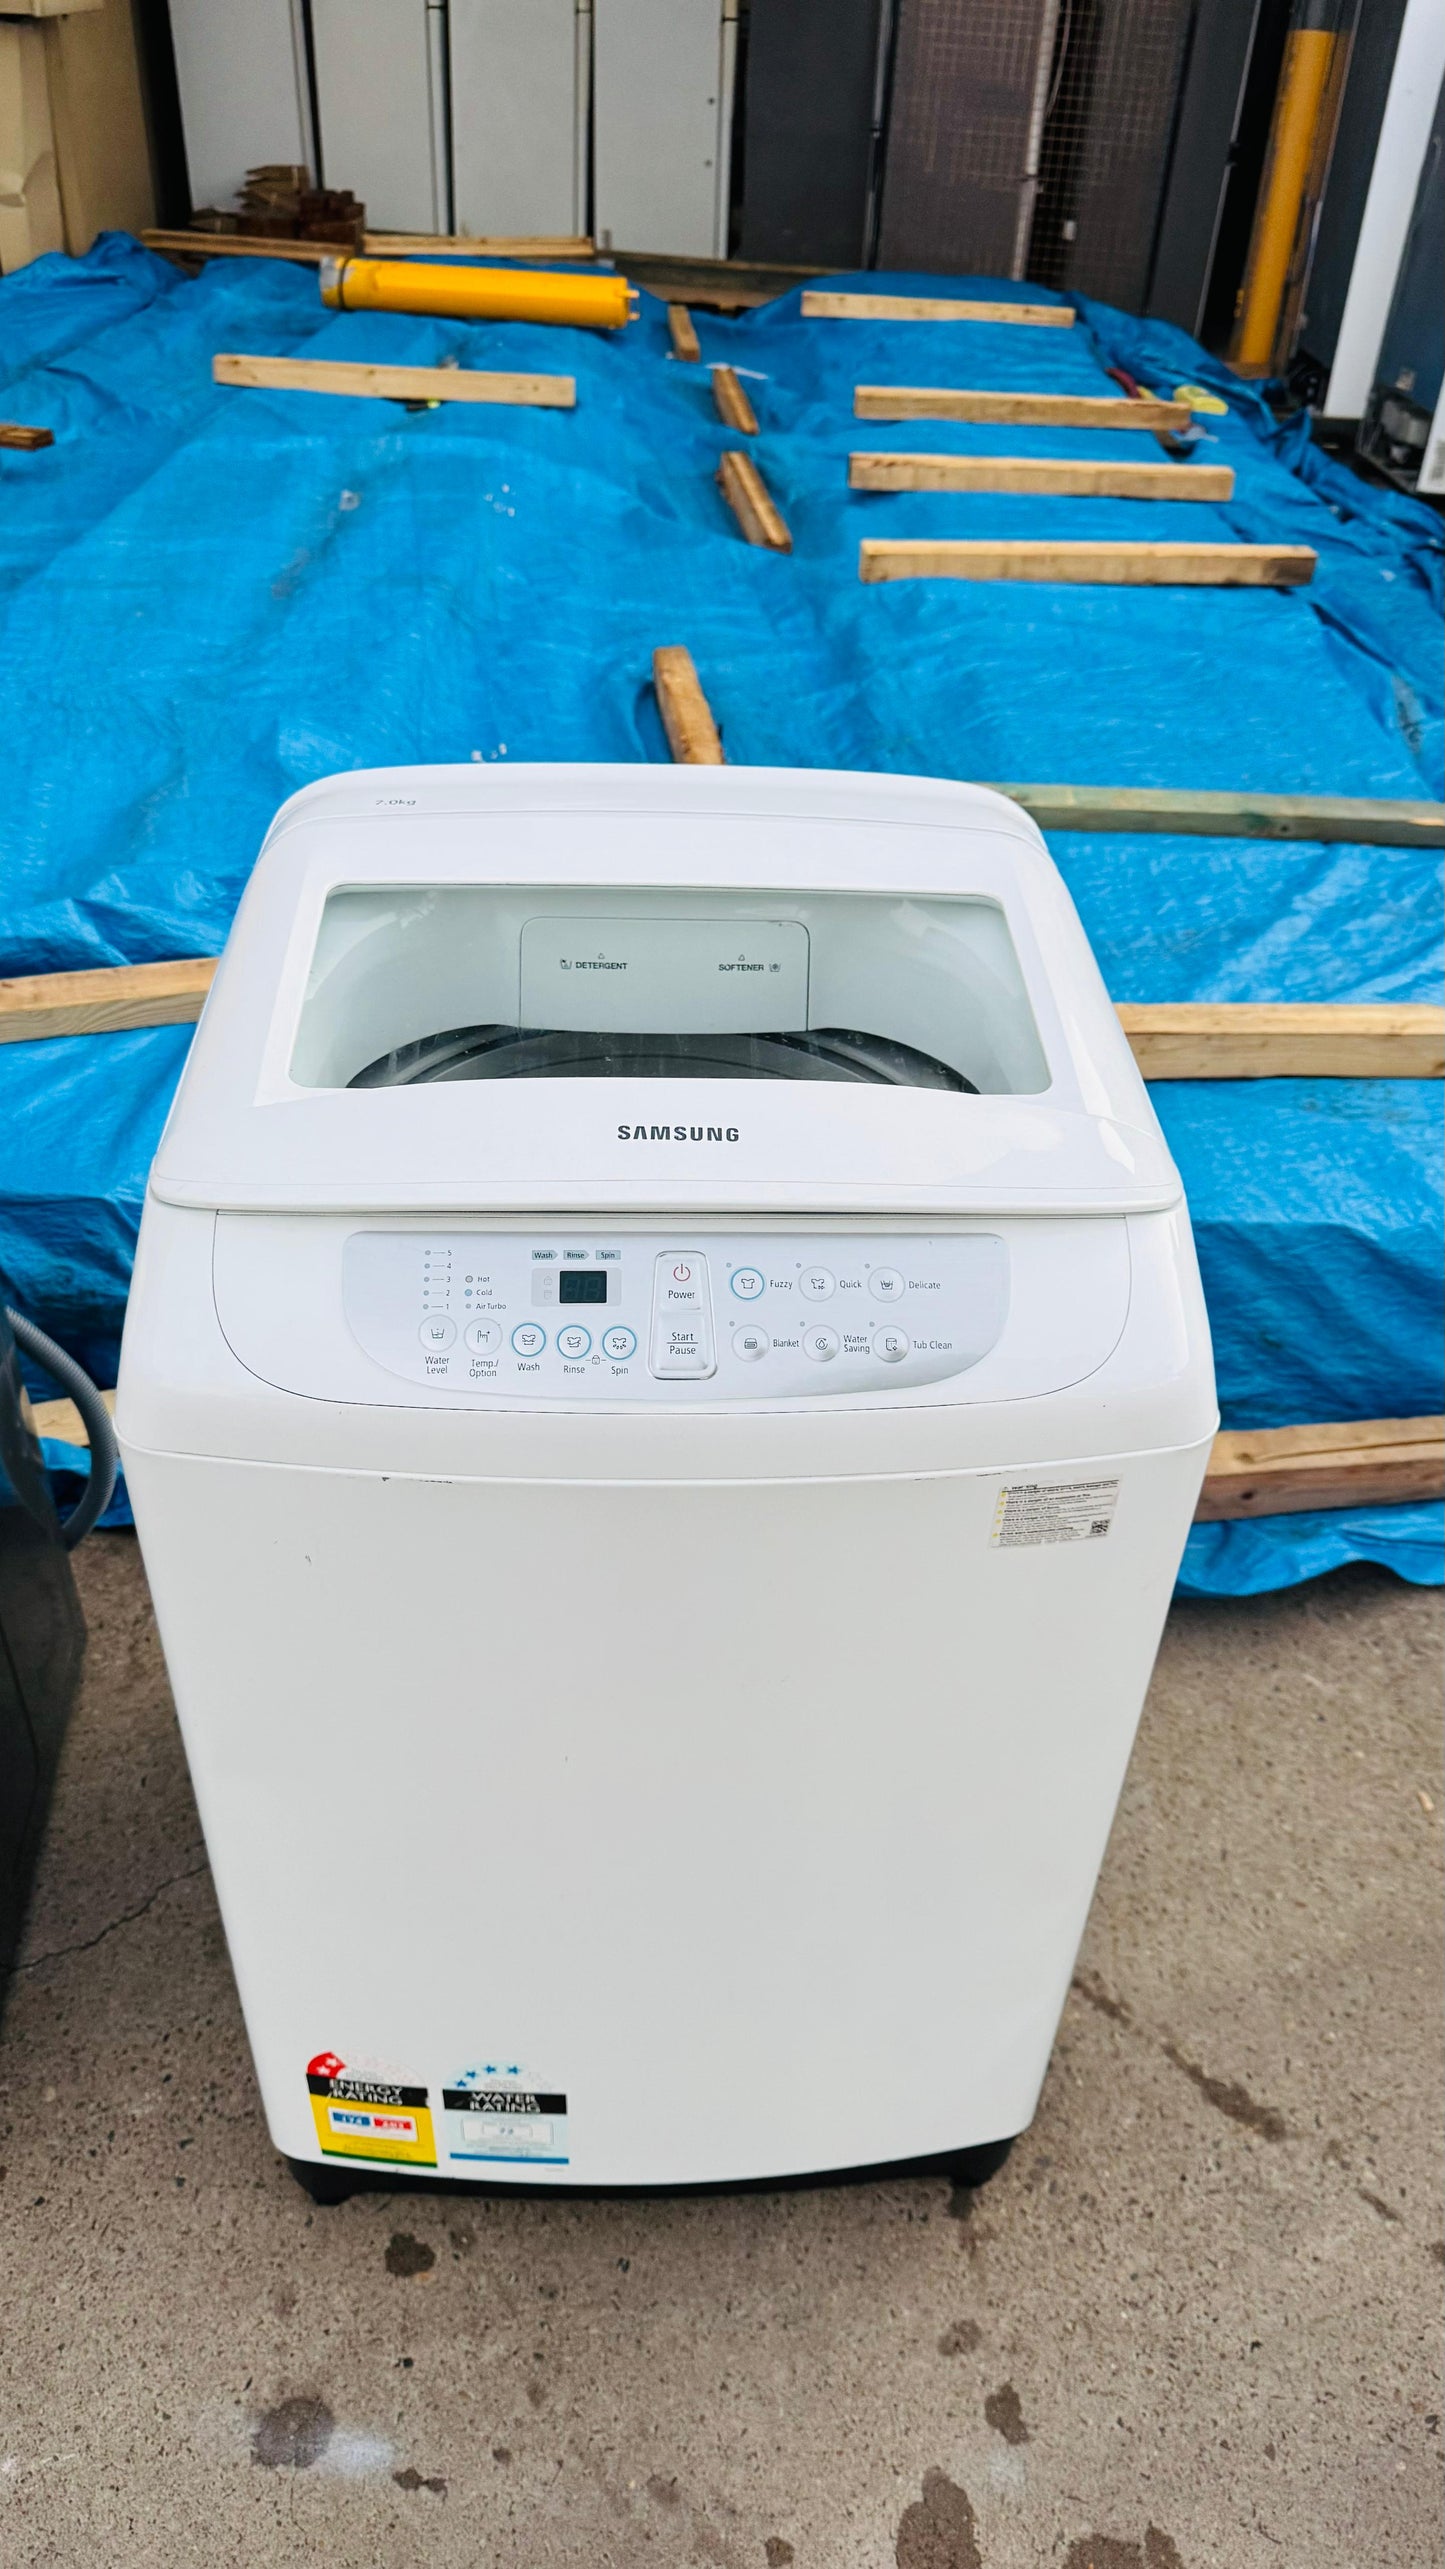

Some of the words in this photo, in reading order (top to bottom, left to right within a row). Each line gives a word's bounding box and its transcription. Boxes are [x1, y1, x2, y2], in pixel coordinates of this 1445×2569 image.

[575, 961, 628, 970] DETERGENT
[718, 963, 765, 972] SOFTENER
[617, 1125, 740, 1142] SAMSUNG
[600, 1252, 616, 1260] Spin
[769, 1280, 793, 1290] Fuzzy
[839, 1280, 863, 1289] Quick
[908, 1281, 941, 1290] Delicate
[668, 1290, 695, 1299] Power
[671, 1332, 694, 1342] Start
[843, 1335, 868, 1343] Water
[773, 1339, 800, 1348] Blanket
[913, 1341, 928, 1349] Tub
[929, 1341, 953, 1350] Clean
[669, 1345, 696, 1355] Pause
[843, 1344, 871, 1354] Saving
[425, 1356, 450, 1365] Water
[471, 1359, 499, 1369] Temp./
[426, 1366, 448, 1375] Level
[517, 1362, 541, 1372] Wash
[563, 1365, 585, 1374] Rinse
[611, 1366, 629, 1376] Spin
[469, 1368, 497, 1379] Option
[329, 2079, 403, 2096] ENERGY
[333, 2089, 403, 2106] RATING
[472, 2091, 536, 2104] WATER
[469, 2101, 541, 2113] RATING
